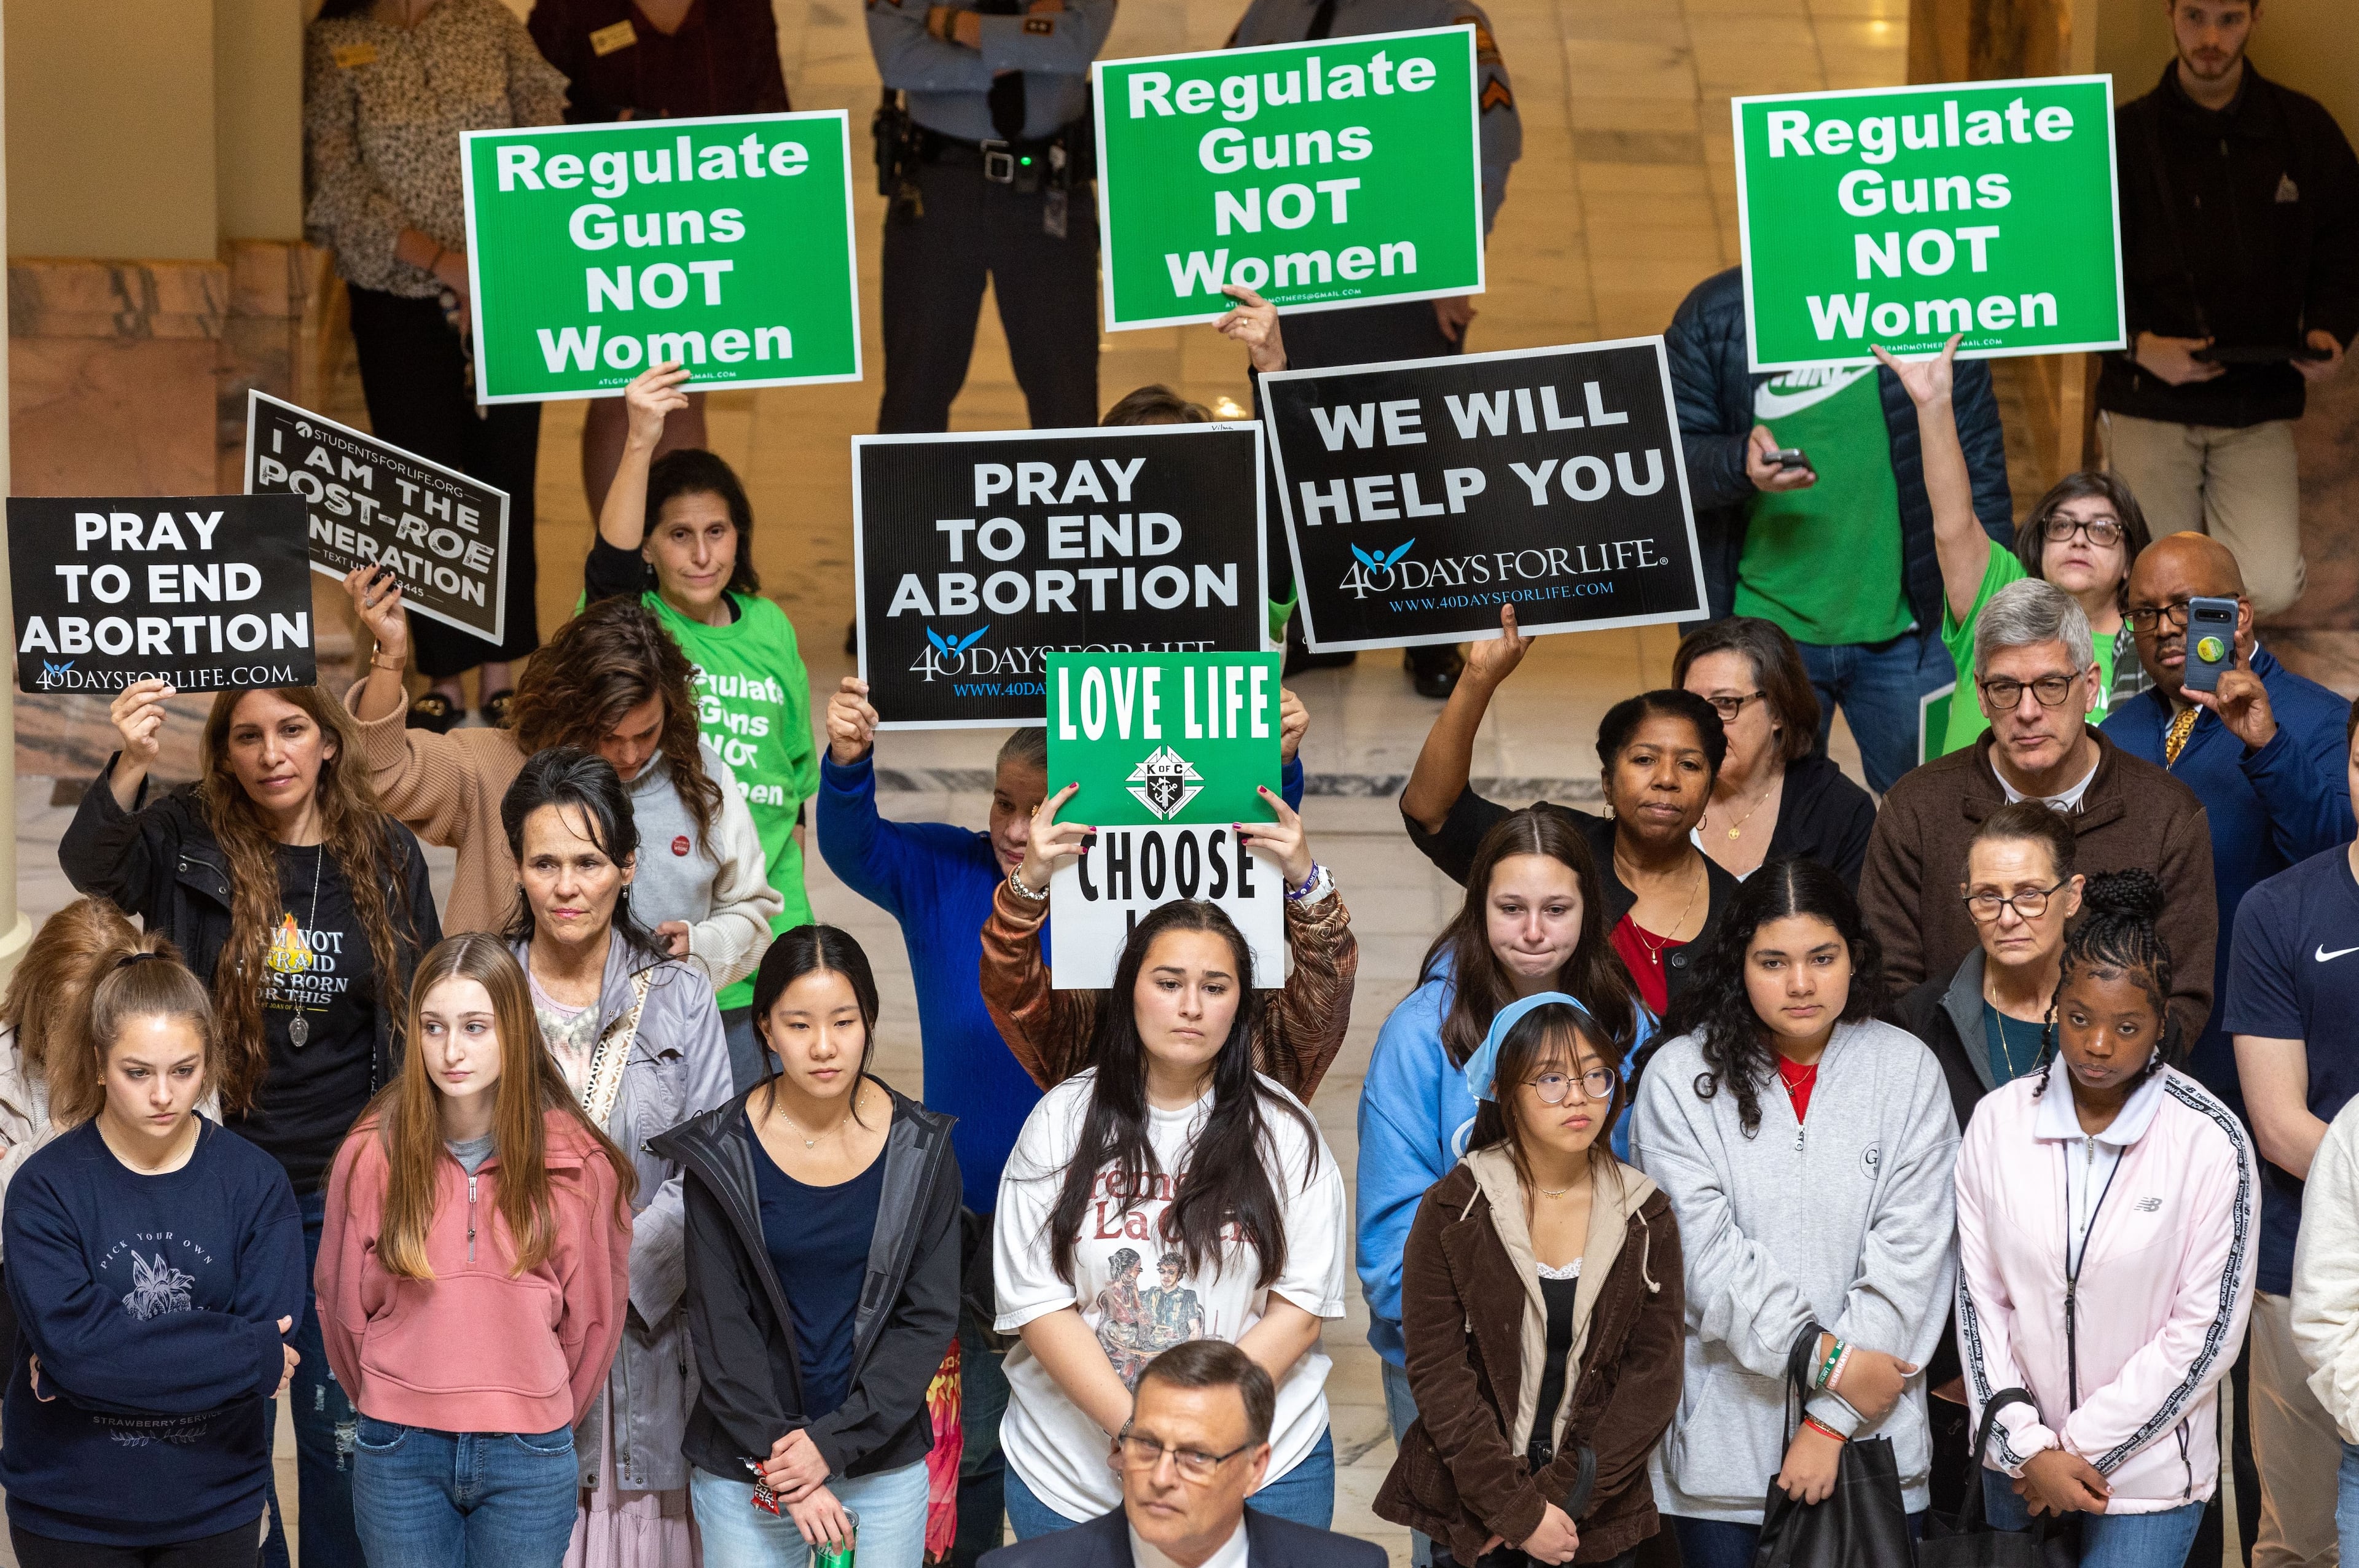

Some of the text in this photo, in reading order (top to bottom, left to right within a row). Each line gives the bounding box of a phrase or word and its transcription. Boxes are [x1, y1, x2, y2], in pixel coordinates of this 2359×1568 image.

[1128, 50, 1436, 121] Regulate
[1198, 125, 1374, 174] Guns
[1767, 96, 2074, 165] Regulate
[496, 132, 809, 199] Regulate
[1215, 177, 1361, 236] NOT
[1837, 169, 2012, 217] Guns
[568, 203, 746, 251] Guns
[1165, 240, 1417, 298] Women
[1854, 225, 2000, 280] NOT
[585, 259, 734, 313] NOT
[1806, 290, 2058, 341] Women
[537, 324, 792, 373] Women
[1310, 381, 1629, 451] WE WILL
[272, 429, 480, 534] I AM THE
[974, 457, 1147, 507] PRAY
[1299, 448, 1666, 526] HELP YOU
[74, 510, 224, 552] PRAY
[259, 455, 495, 574] POST-ROE
[936, 512, 1183, 562] TO END
[309, 515, 485, 607] NERATION
[323, 548, 348, 566] TEXT
[55, 562, 262, 604] TO END
[886, 562, 1238, 618] ABORTION
[1389, 582, 1614, 613] WWW.40DAYSFORLIFE.COM
[19, 611, 309, 656] ABORTION
[1058, 665, 1270, 742] LOVE LIFE
[700, 732, 758, 770] NOT
[1147, 764, 1183, 774] K OF C
[1078, 829, 1256, 902] CHOOSE
[265, 950, 336, 973] FRAID
[295, 929, 344, 953] NOT
[284, 988, 333, 1004] THIS
[292, 973, 349, 993] BORN
[1093, 1200, 1150, 1241] La
[100, 1231, 213, 1270] PICK YOUR OWN
[93, 1415, 177, 1427] STRAWBERRY
